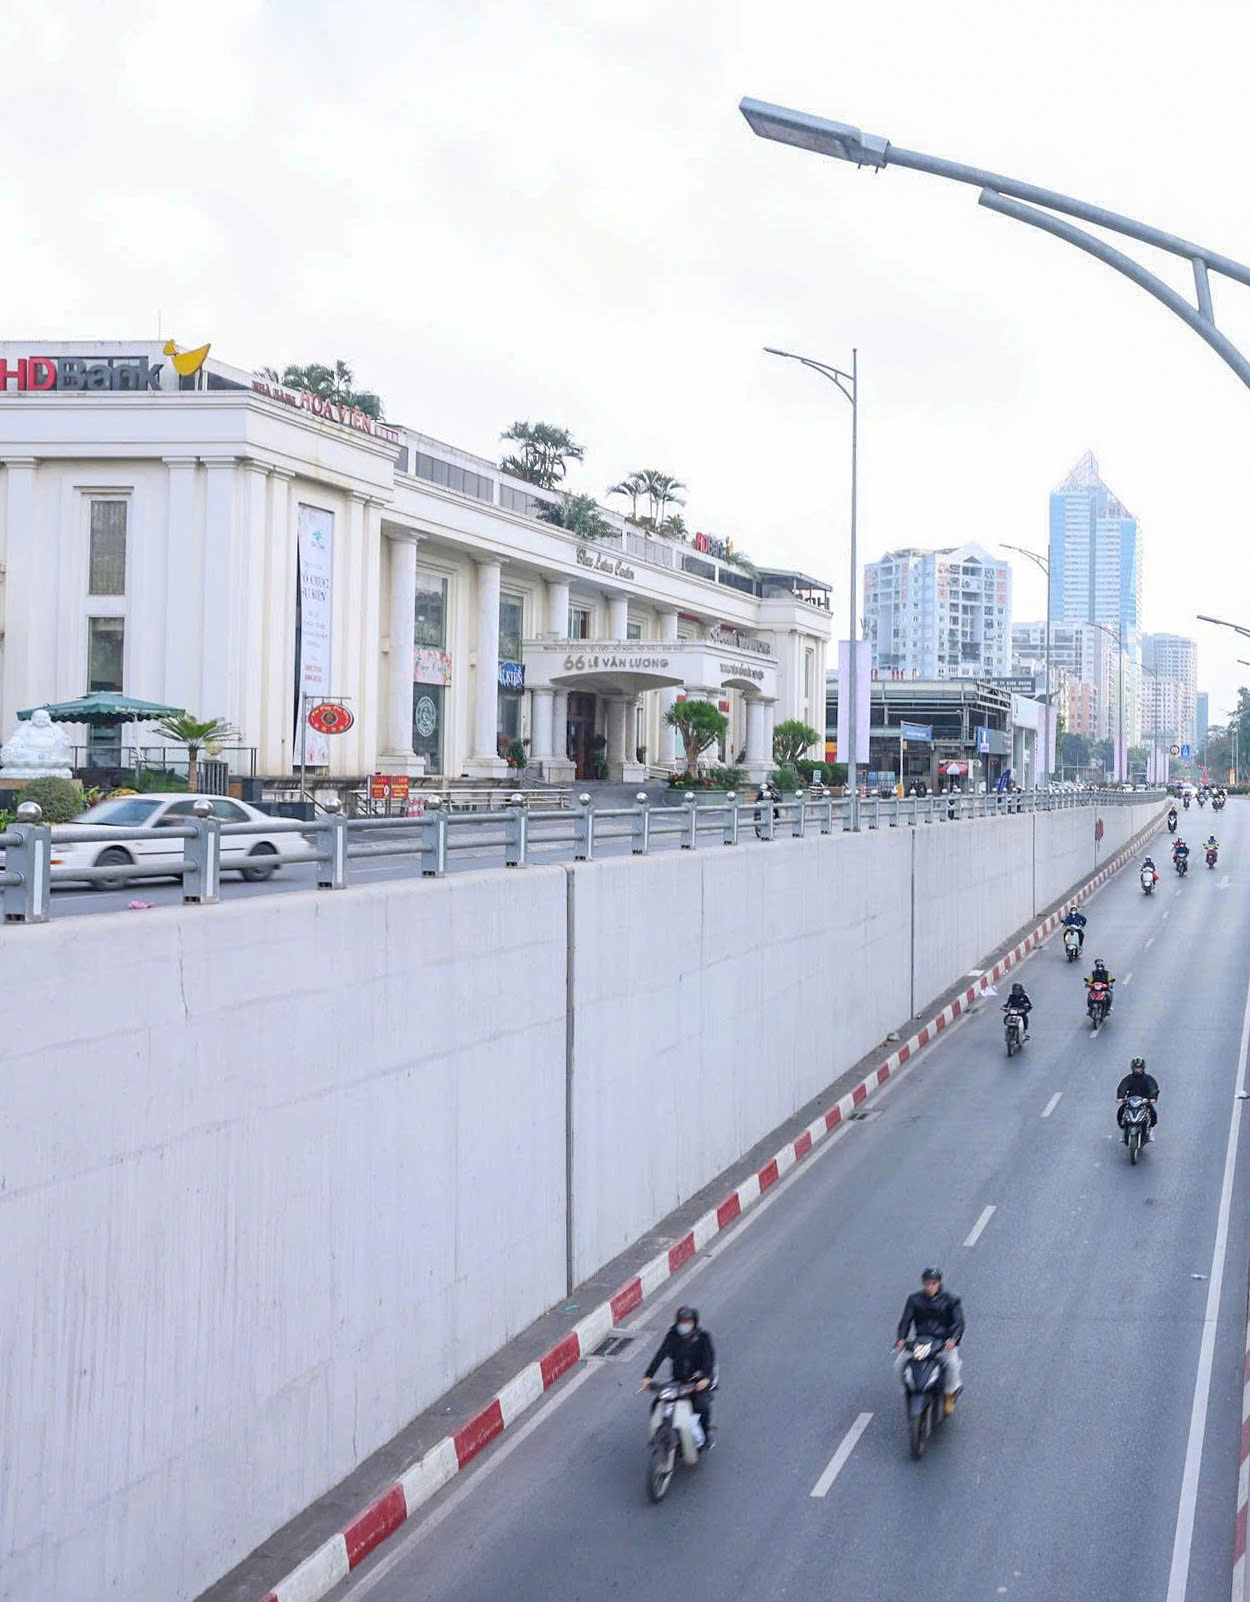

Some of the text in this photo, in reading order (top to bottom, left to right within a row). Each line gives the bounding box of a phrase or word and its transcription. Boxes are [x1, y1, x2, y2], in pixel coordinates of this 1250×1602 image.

[0, 357, 164, 391] HDBank
[564, 655, 669, 670] 66 LÊ VĂN LƯƠNG
